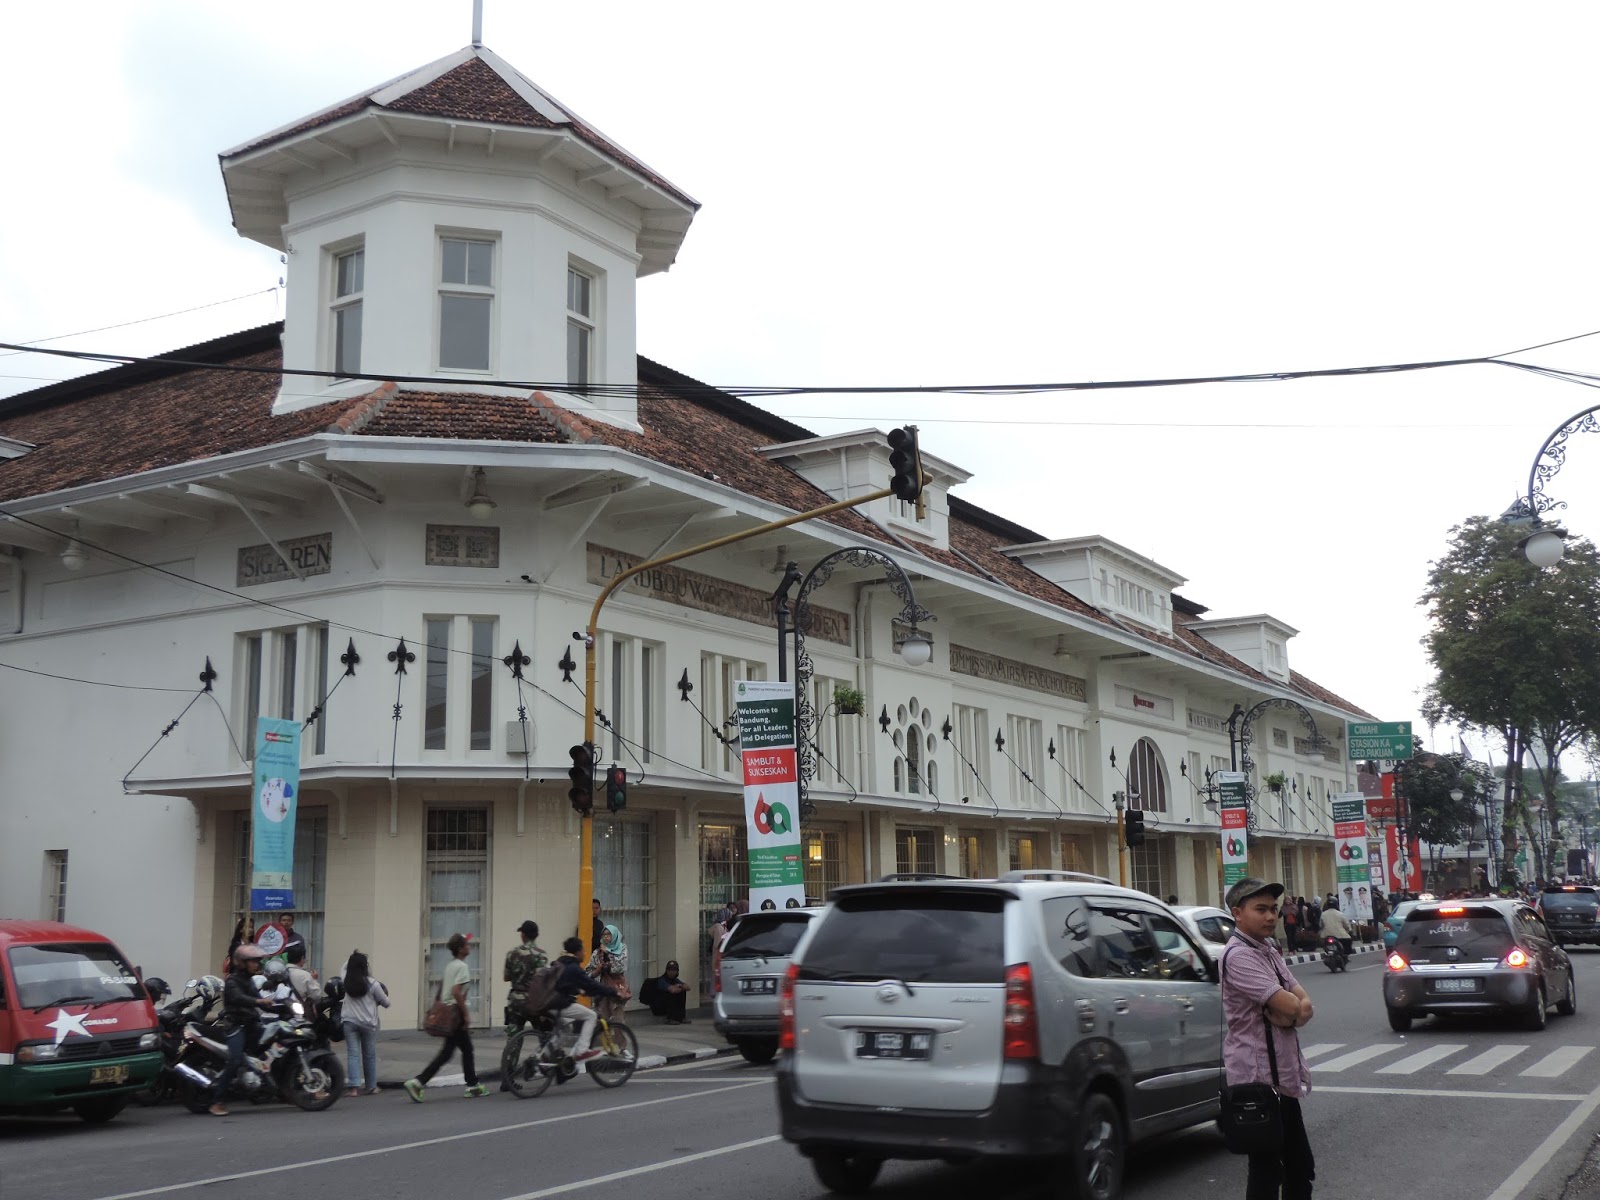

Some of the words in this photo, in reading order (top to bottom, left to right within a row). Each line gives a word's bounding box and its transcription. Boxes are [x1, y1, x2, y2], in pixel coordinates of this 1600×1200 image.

[244, 542, 331, 578] SIGAREN
[763, 724, 788, 732] Leaders
[1354, 725, 1378, 734] CIMAHI
[754, 732, 792, 741] Delegations
[1350, 739, 1379, 748] STASION
[1380, 739, 1390, 748] KA
[1351, 748, 1393, 758] GED.PAKUAN
[747, 757, 775, 766] SAMBUT
[748, 767, 788, 776] SUKSESKAN
